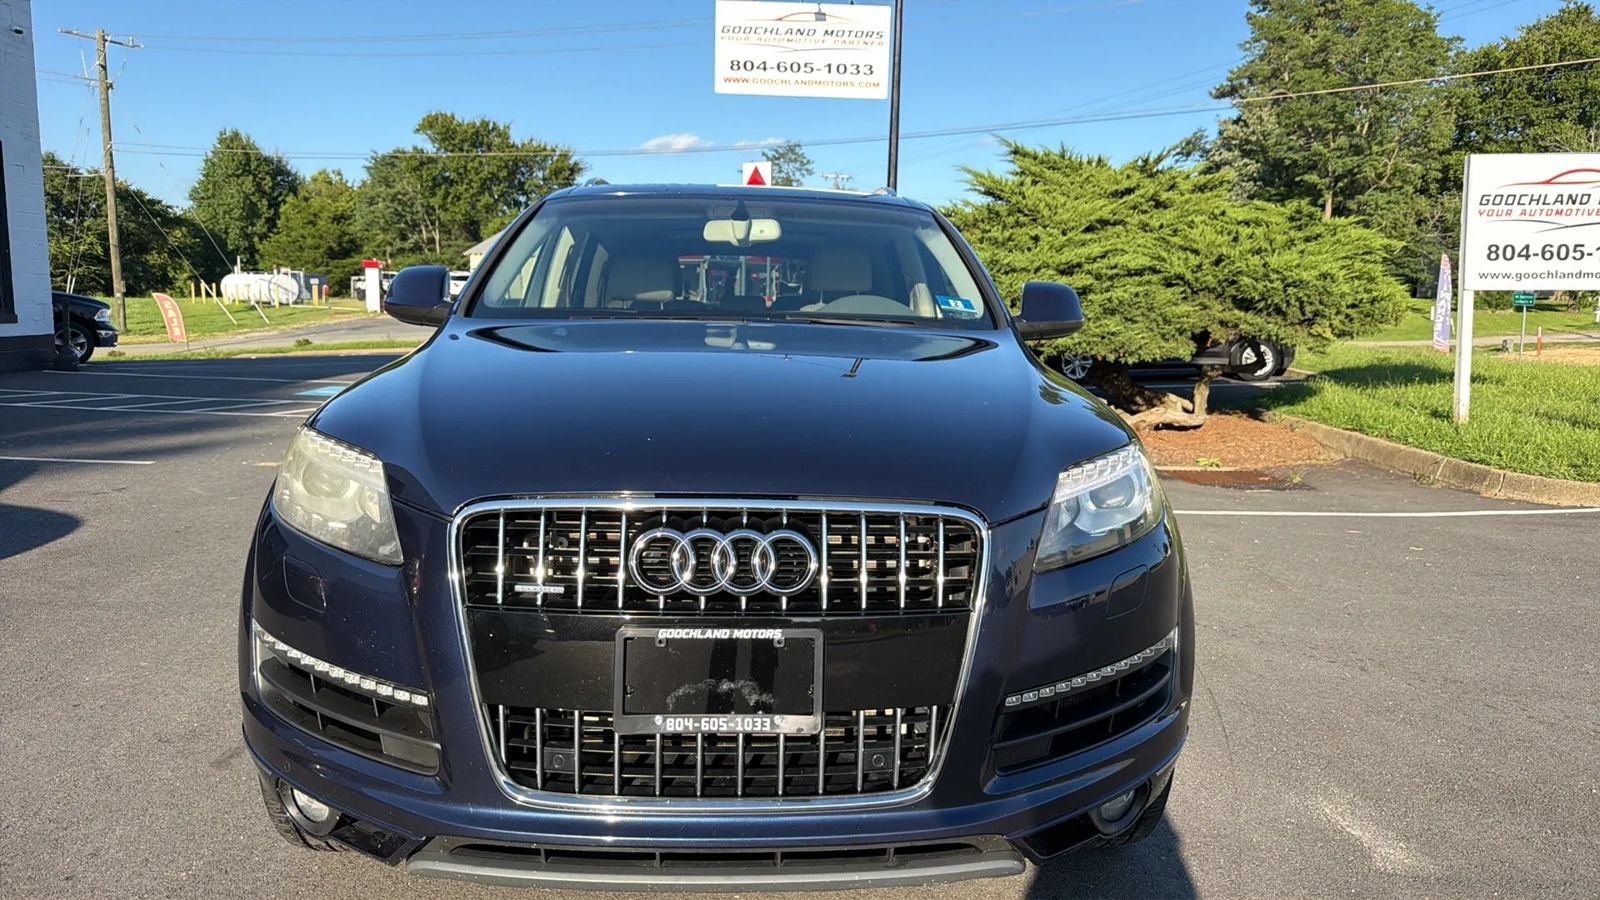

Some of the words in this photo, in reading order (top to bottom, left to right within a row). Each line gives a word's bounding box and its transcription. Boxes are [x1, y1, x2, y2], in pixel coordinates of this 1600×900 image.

[721, 25, 816, 37] GOOCHLAND
[823, 29, 884, 39] MOTORS
[730, 59, 874, 76] 804-605-1033
[1479, 194, 1592, 206] GOOCHLAND
[1478, 209, 1513, 217] YOUR
[657, 629, 730, 639] GOOCHLAND
[732, 629, 782, 639] MOTORS
[666, 718, 771, 731] 804-605-1033
